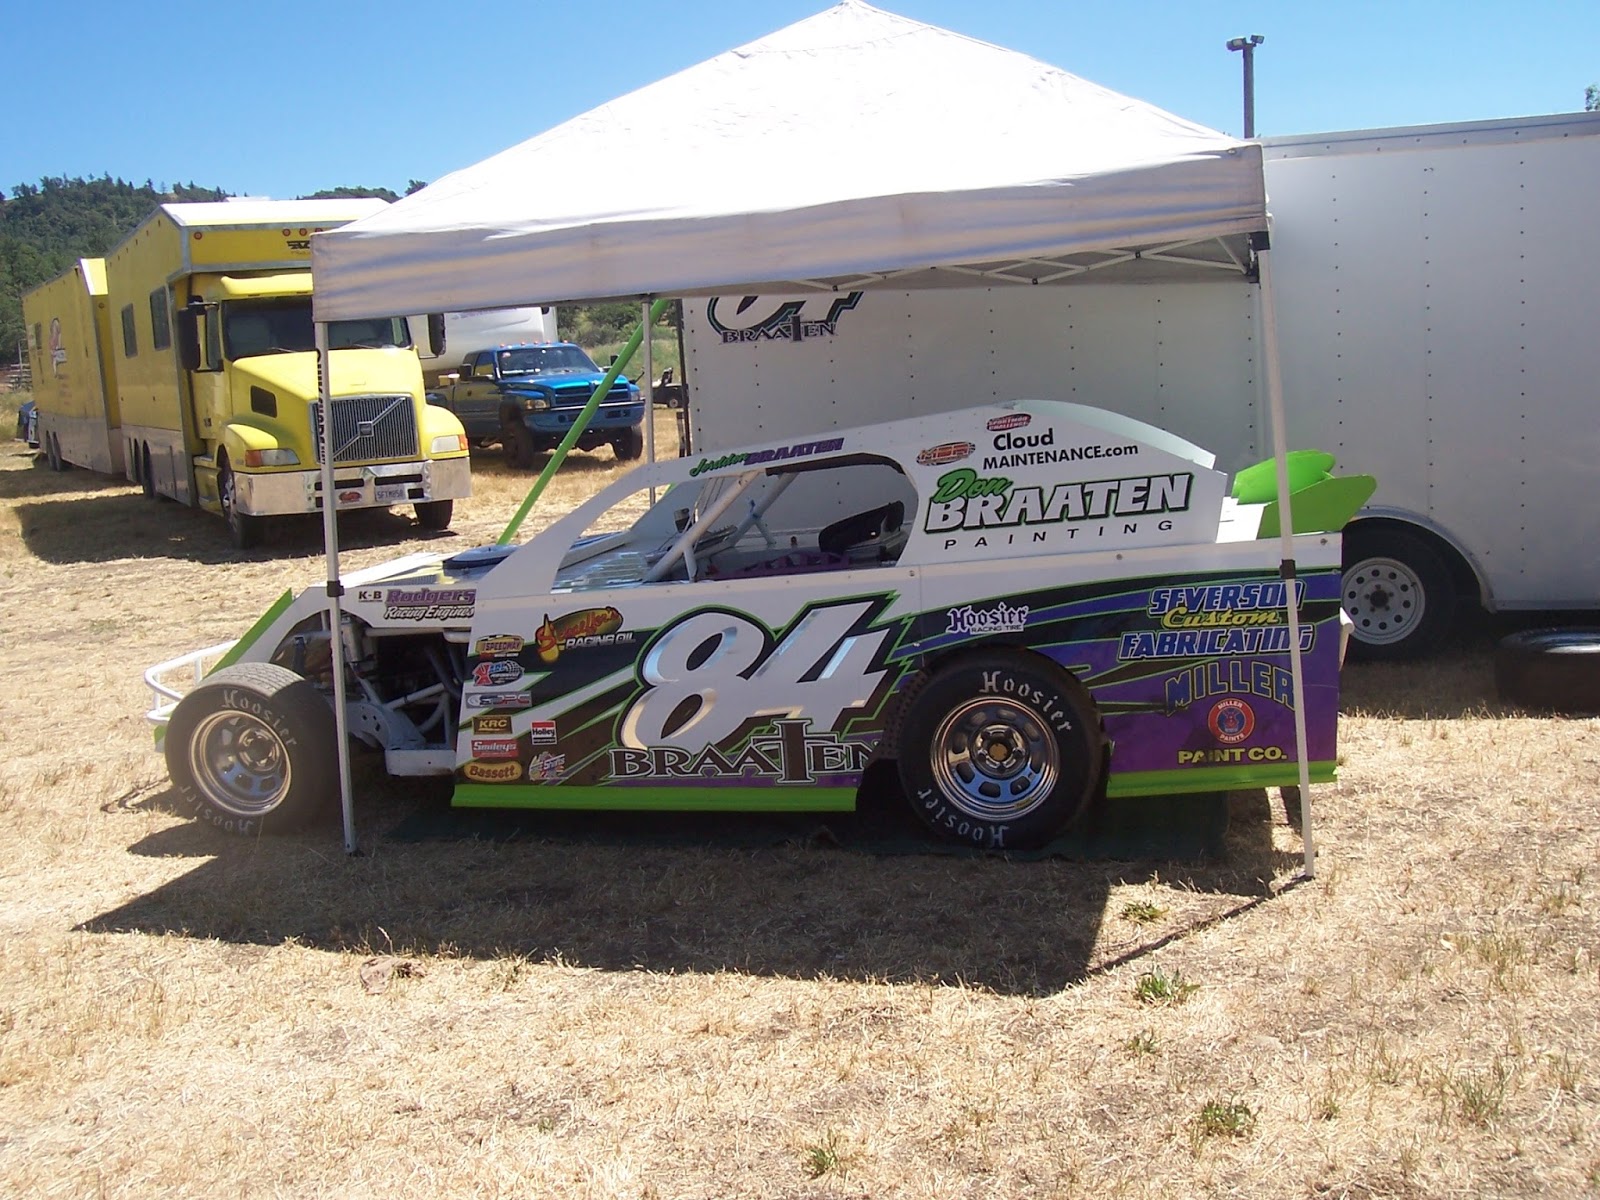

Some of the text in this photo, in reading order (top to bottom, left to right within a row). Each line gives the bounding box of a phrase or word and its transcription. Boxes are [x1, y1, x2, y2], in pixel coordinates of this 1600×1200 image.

[720, 314, 837, 343] BRAATEN
[744, 437, 845, 466] BRAATEN
[993, 428, 1054, 451] Cloud
[983, 444, 1139, 470] MAINTENANCE.com
[932, 467, 1013, 504] Don
[924, 472, 1194, 534] BRAATEN
[944, 519, 1174, 549] PAINTING
[359, 591, 382, 600] K-B
[1149, 582, 1304, 615] SEVERSON
[384, 605, 475, 620] Racing Engines
[946, 601, 1030, 633] Hoosier
[1163, 606, 1281, 628] Custom
[565, 632, 636, 649] RACING OIL
[971, 625, 1002, 633] RACING
[1119, 624, 1315, 660] FABRICATING
[484, 640, 521, 651] SPEEDWAY
[619, 601, 890, 752] 84
[1165, 660, 1297, 717] MILLER
[979, 670, 1073, 732] Hoosier
[221, 689, 298, 747] Hoosier
[479, 719, 507, 728] KRC
[532, 728, 556, 736] Holley
[1247, 746, 1288, 761] CO.
[917, 788, 1010, 848] Hoosier
